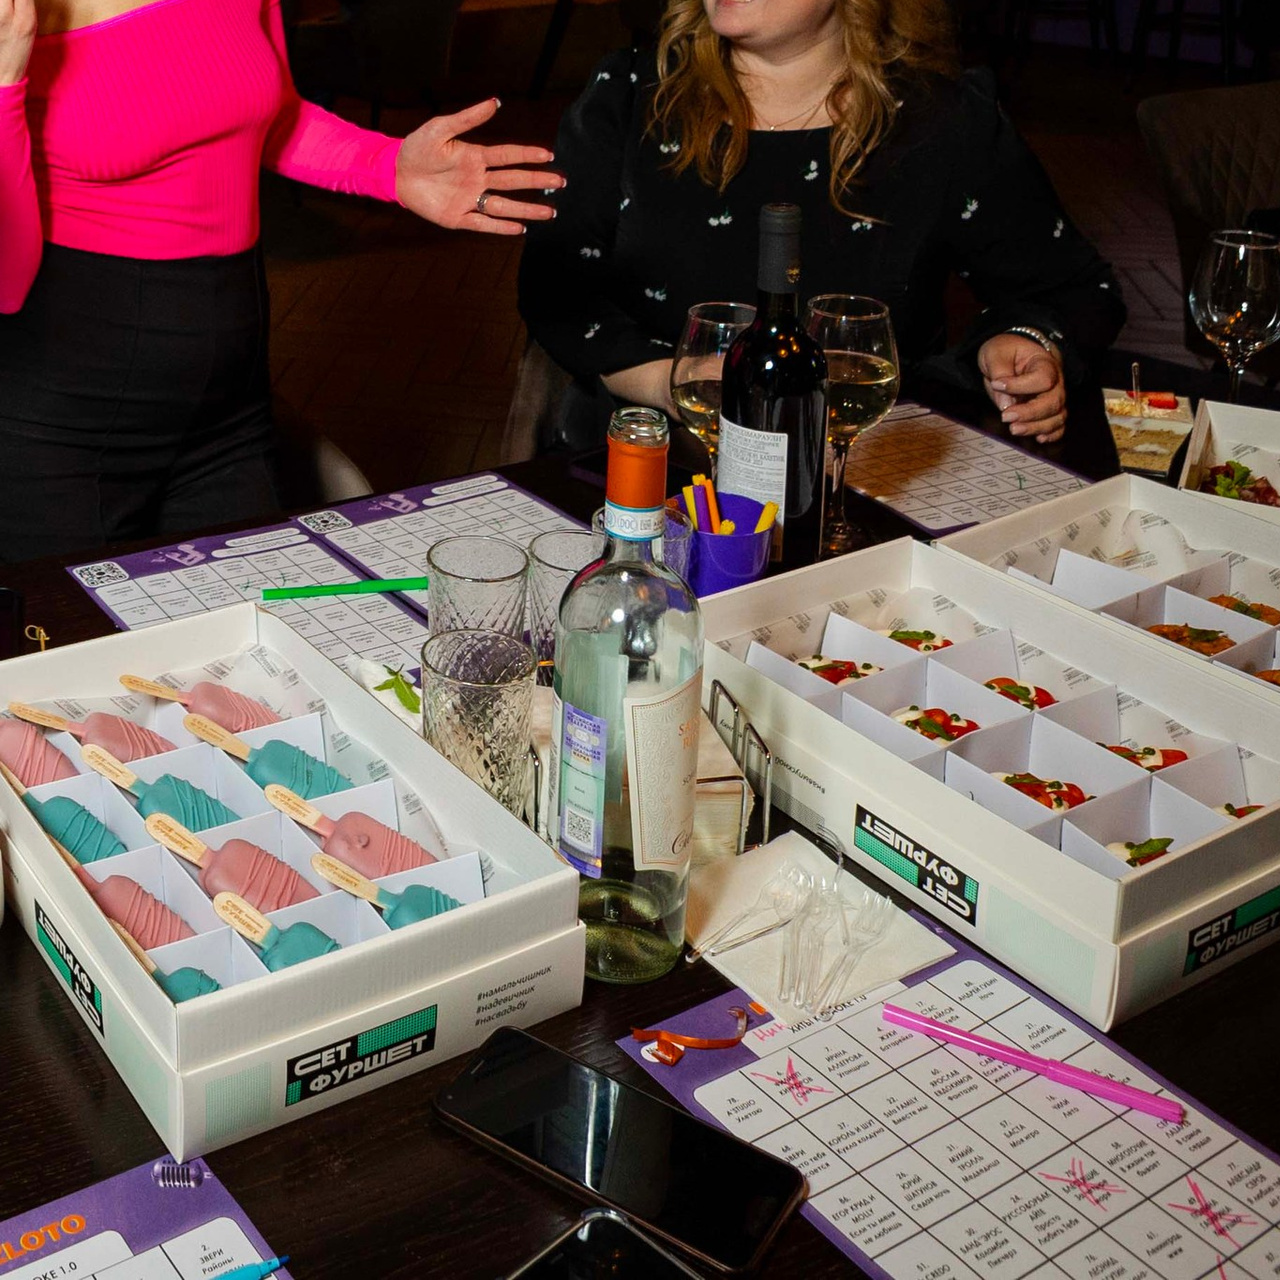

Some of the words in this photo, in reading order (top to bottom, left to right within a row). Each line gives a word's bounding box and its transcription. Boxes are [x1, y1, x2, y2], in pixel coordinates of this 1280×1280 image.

[862, 813, 958, 886] ФУРШЕТ
[923, 877, 970, 918] СЕТ
[1193, 915, 1232, 947] СЕТ
[1199, 911, 1280, 963] ФУРШЕТ
[38, 910, 92, 994] ФУРШЕТ
[477, 965, 552, 1001] #намальчишник
[958, 985, 982, 1002] АНДРЕЙ
[980, 976, 999, 991] ГУБИН
[74, 982, 102, 1027] СЕТ
[476, 985, 536, 1014] #надевичник
[475, 1000, 528, 1027] #насвадьбу
[921, 1005, 937, 1014] СТАС
[788, 1017, 813, 1034] ХИТЫ
[1028, 1024, 1053, 1040] ЛОЛИТА
[878, 1030, 898, 1042] ЖУКИ
[880, 1034, 914, 1052] Батарейка
[293, 1041, 351, 1077] СЕТ
[308, 1034, 428, 1094] ФУРШЕТ
[825, 1050, 848, 1062] ИРИНА
[827, 1052, 863, 1072] АЛЛЕГРОВА
[930, 1070, 960, 1088] ЯРОСЛАВ
[934, 1074, 973, 1097] ЕВДОКИМОВ
[891, 1109, 916, 1126] Вместе
[828, 1128, 855, 1147] КОРОЛЬ
[861, 1118, 876, 1132] ШУТ
[1004, 1124, 1026, 1138] БАСТА
[1009, 1135, 1025, 1149] Моя
[1023, 1129, 1040, 1143] игра
[836, 1139, 858, 1155] Кукла
[856, 1126, 885, 1146] колдуна
[807, 1151, 827, 1165] тебя
[948, 1146, 974, 1164] МУМИЙ
[958, 1155, 984, 1171] ТРОЛЛЬ
[900, 1174, 922, 1190] ЮРИЙ
[904, 1181, 938, 1202] ШАТУНОВ
[911, 1196, 933, 1212] Седая
[831, 1206, 850, 1222] ЕГОР
[851, 1208, 874, 1224] MOLLY
[199, 1248, 224, 1264] ЗВЕРИ
[60, 1261, 77, 1275] 1.0
[202, 1257, 234, 1275] Районы
